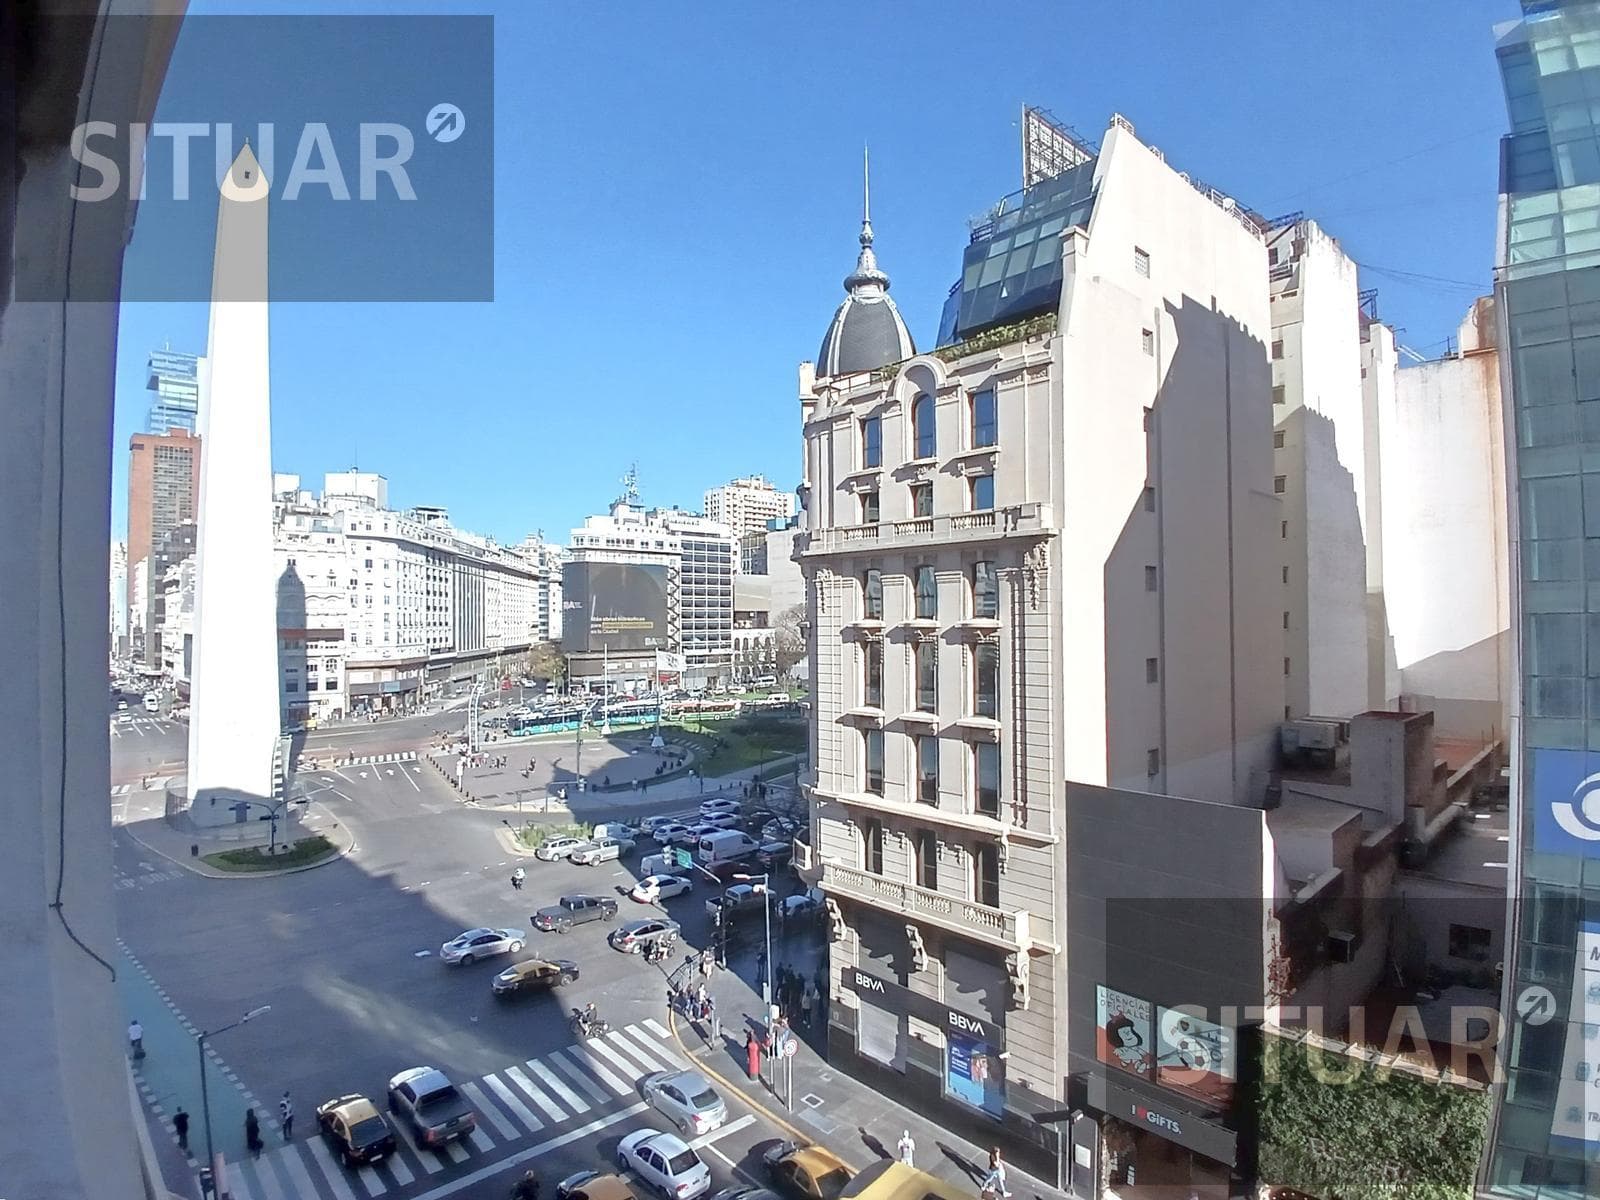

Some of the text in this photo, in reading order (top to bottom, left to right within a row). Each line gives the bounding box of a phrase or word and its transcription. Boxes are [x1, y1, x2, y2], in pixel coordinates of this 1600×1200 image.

[855, 972, 885, 993] BBVA
[1100, 990, 1150, 1013] LICENCIAS
[1100, 999, 1150, 1022] OFICIALES
[948, 1012, 985, 1036] BBVA
